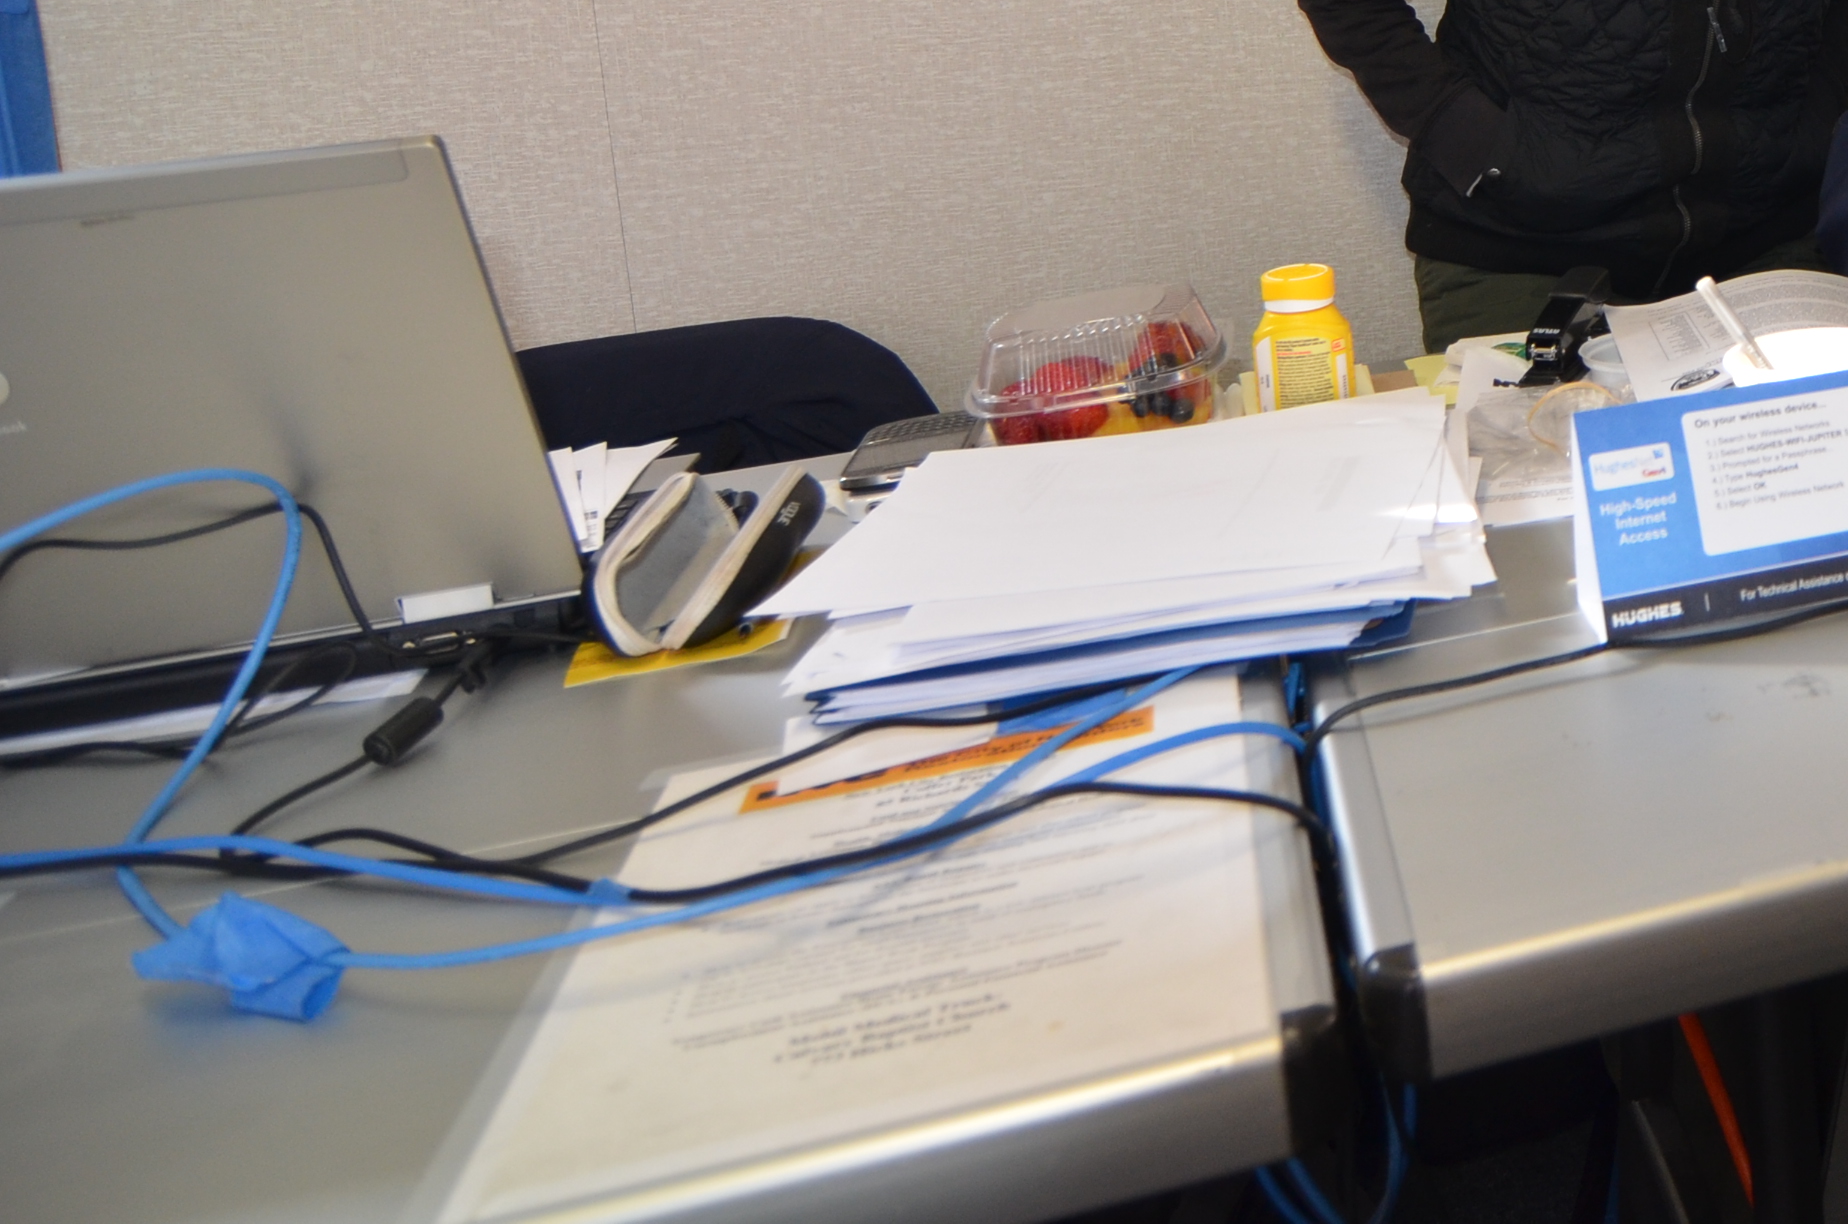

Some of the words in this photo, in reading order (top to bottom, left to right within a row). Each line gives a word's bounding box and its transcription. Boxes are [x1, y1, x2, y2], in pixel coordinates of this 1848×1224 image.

[1694, 418, 1711, 429] On
[1713, 415, 1736, 428] your
[1739, 407, 1782, 424] wireless
[1753, 481, 1767, 490] OK
[1600, 492, 1677, 518] High-Speed
[1615, 511, 1667, 530] Internet
[1619, 527, 1668, 546] Access
[1740, 588, 1755, 603] For
[1757, 580, 1798, 600] Technical
[1799, 570, 1844, 592] Assistance
[1611, 601, 1683, 628] HUGHES
